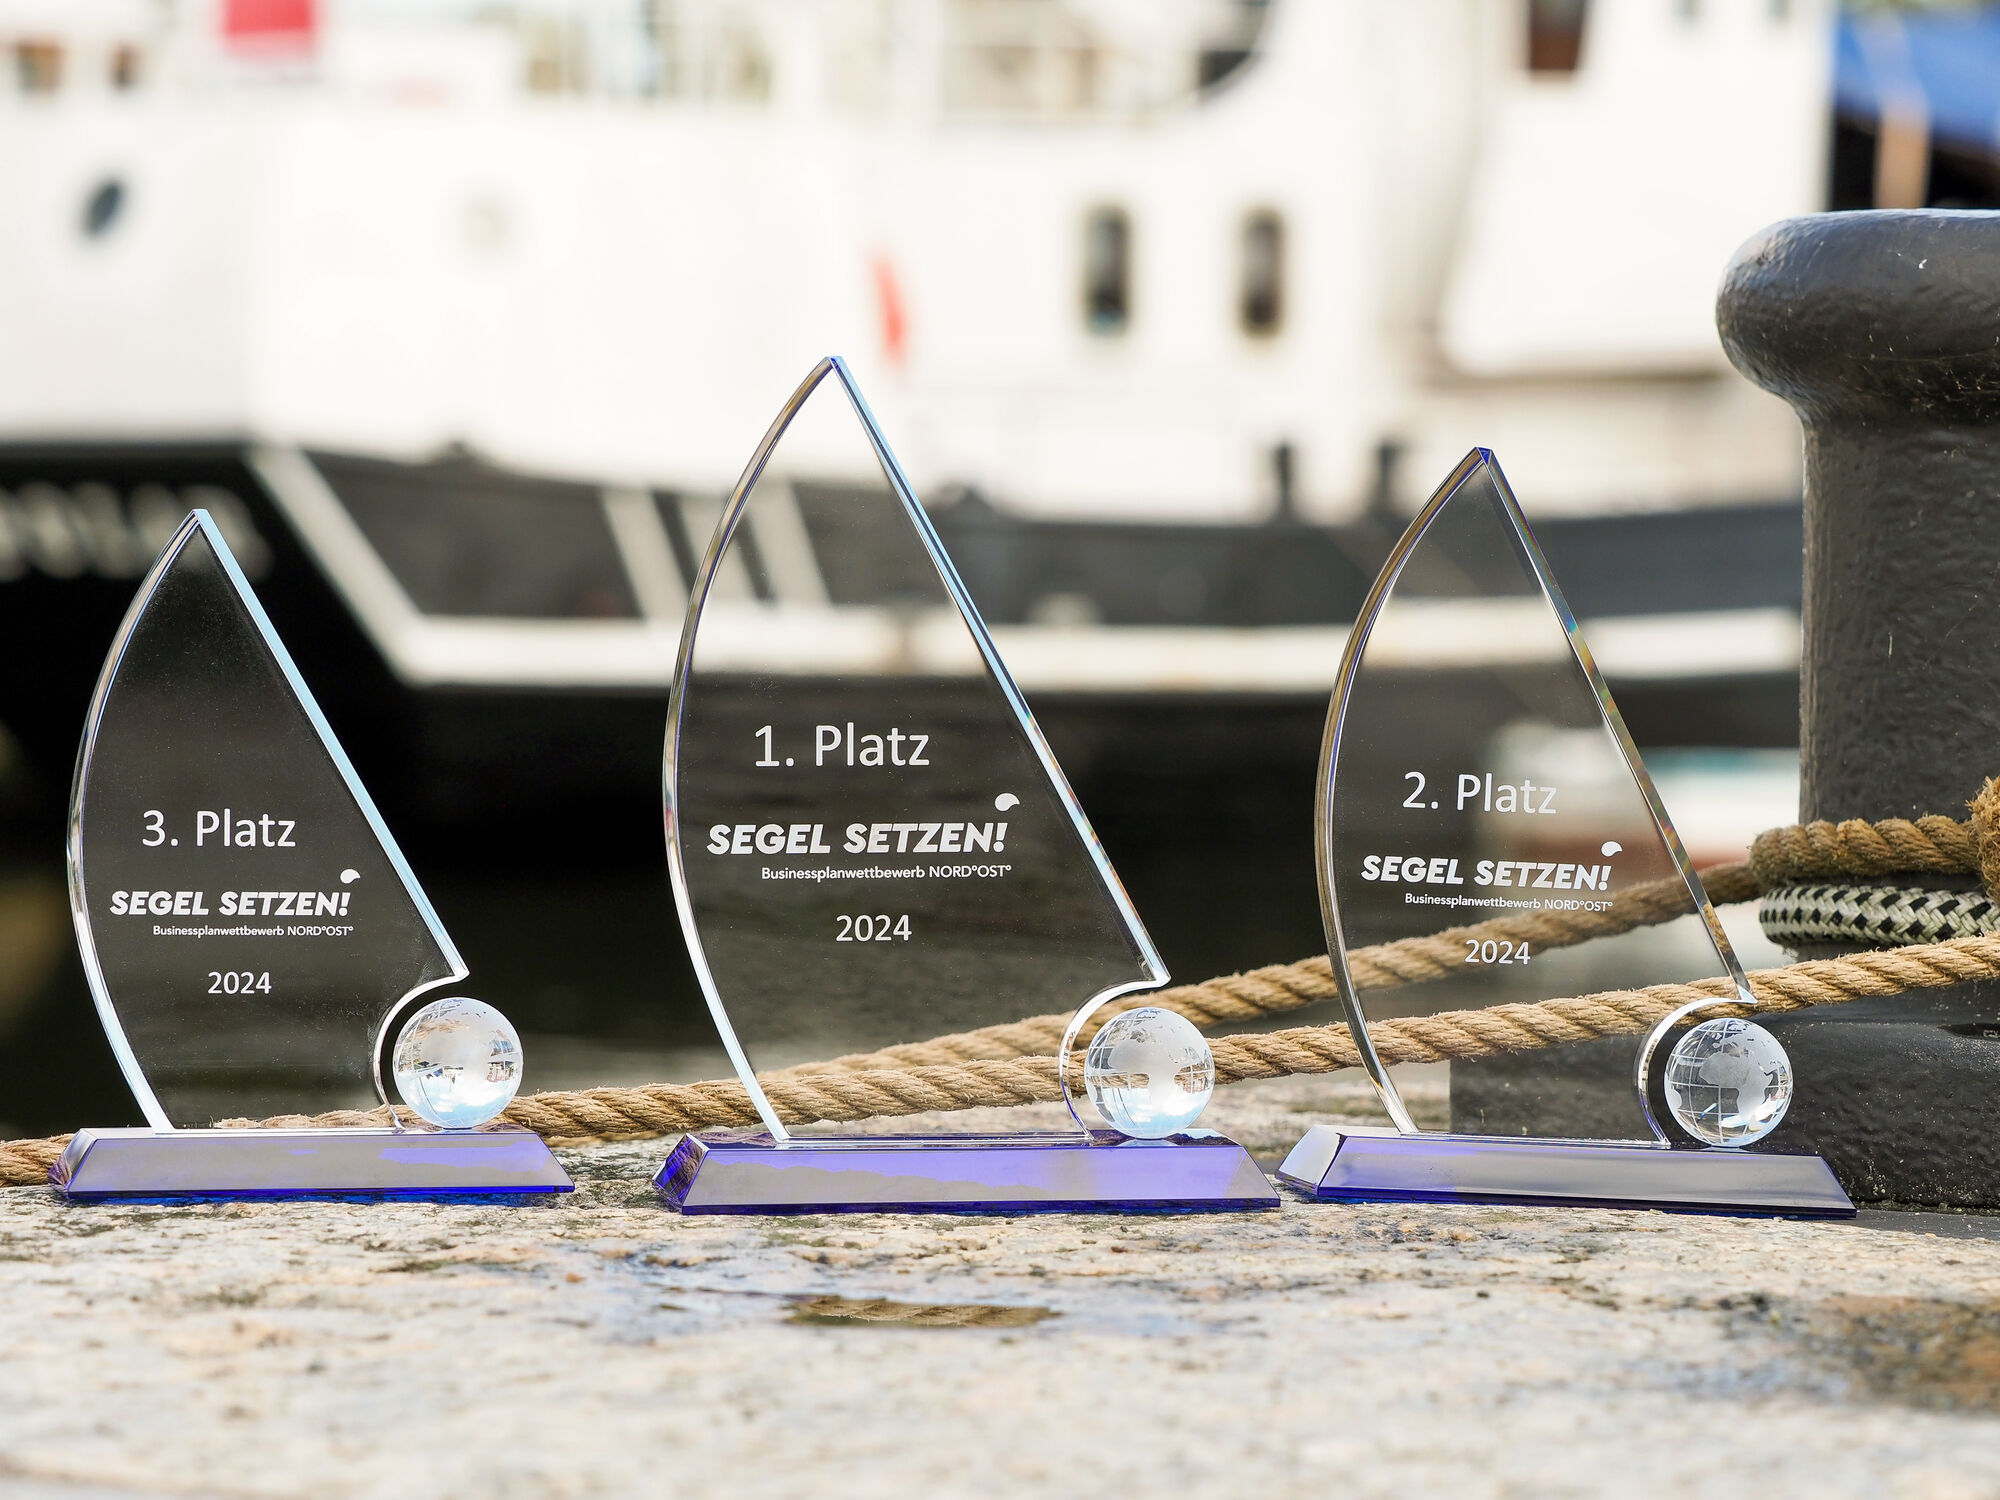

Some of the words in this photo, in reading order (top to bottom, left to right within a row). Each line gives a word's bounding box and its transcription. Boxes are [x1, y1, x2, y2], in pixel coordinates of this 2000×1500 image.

[755, 725, 794, 767] 1.
[815, 722, 930, 766] Platz
[1402, 771, 1439, 810] 2.
[1457, 773, 1557, 814] Platz
[142, 809, 179, 847] 3.
[196, 808, 296, 847] Platz
[706, 823, 831, 855] SEGEL
[842, 822, 1009, 854] SETZEN!
[761, 865, 925, 883] Businessplanwettbewerb
[1361, 855, 1464, 885] SEGEL
[1474, 860, 1612, 891] SETZEN!
[109, 890, 209, 916] SEGEL
[219, 891, 351, 917] SETZEN!
[1405, 893, 1541, 910] Businessplanwettbewerb
[153, 925, 285, 938] Businessplanwettbewerb
[836, 914, 912, 942] 2024
[1464, 939, 1531, 965] 2024
[207, 971, 272, 995] 2024
